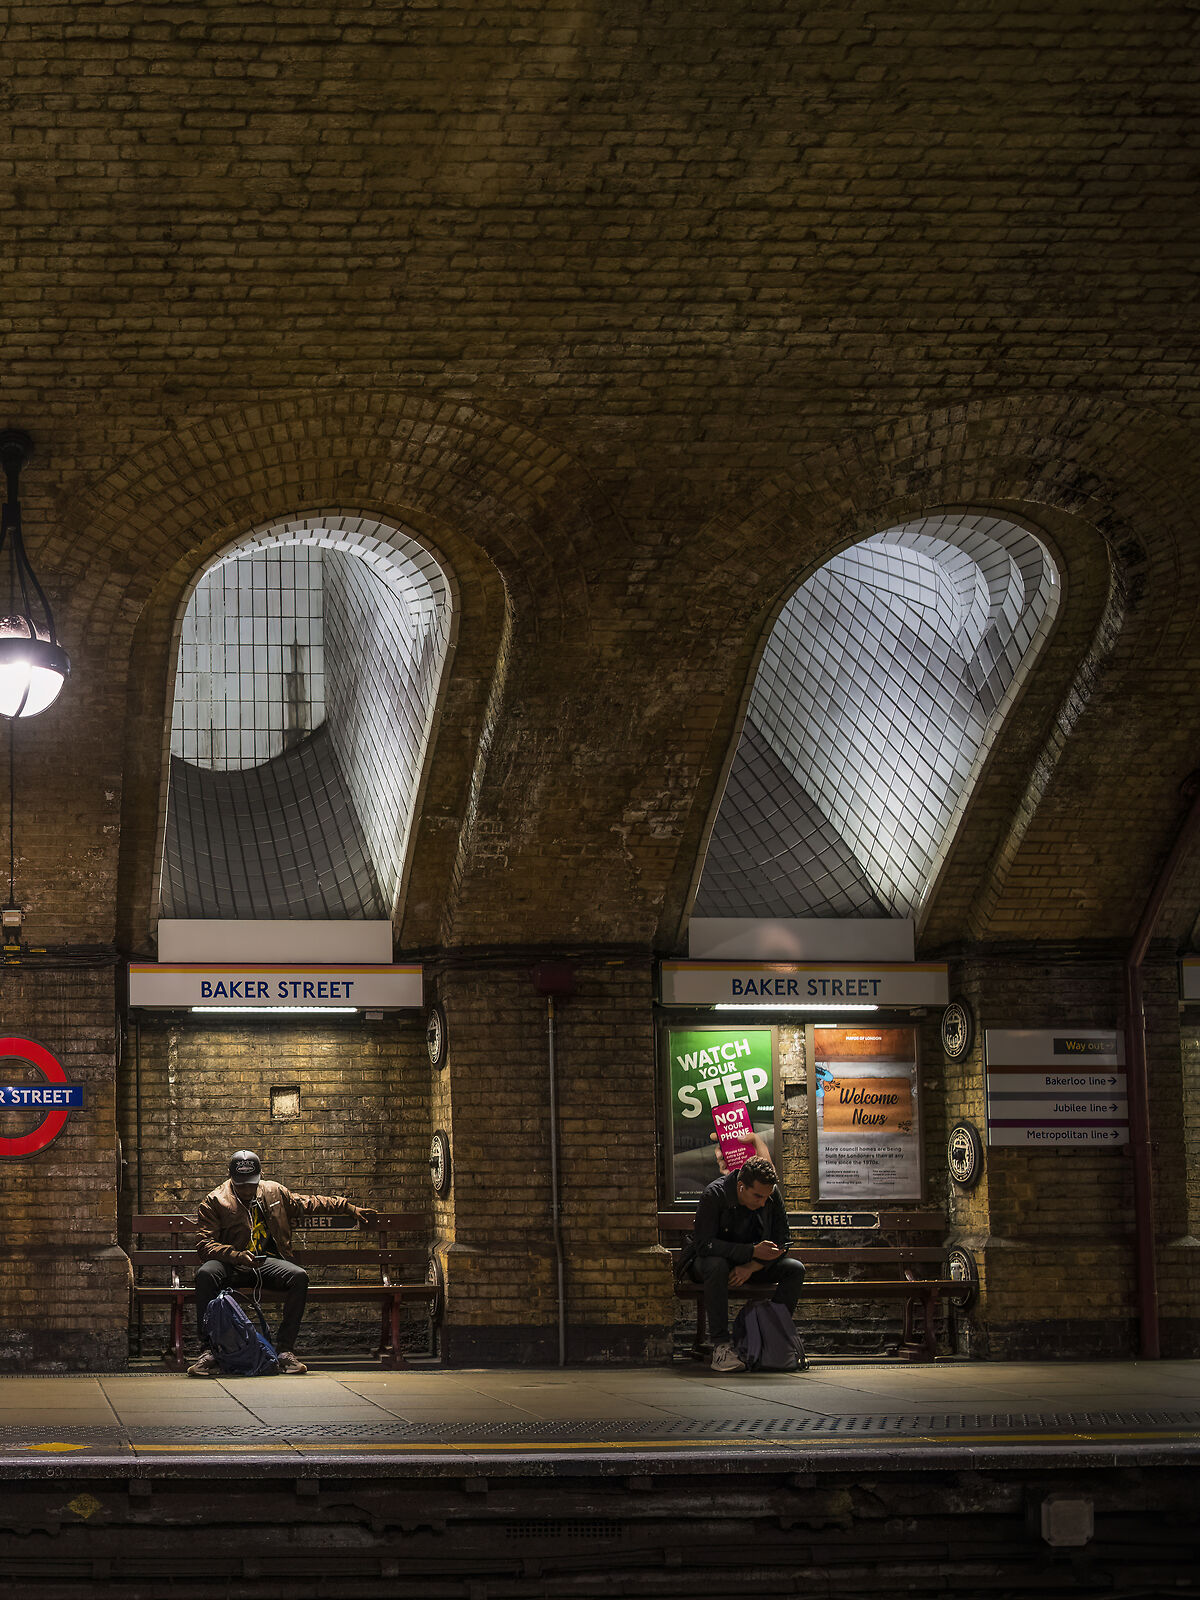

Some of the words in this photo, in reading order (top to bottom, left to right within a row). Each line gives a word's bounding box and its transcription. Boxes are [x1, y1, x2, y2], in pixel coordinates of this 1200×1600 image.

[200, 981, 270, 998] BAKER
[278, 981, 354, 998] STREET
[732, 979, 799, 996] BAKER
[807, 980, 882, 996] STREET
[1065, 1040, 1086, 1052] Way
[1088, 1042, 1104, 1050] out
[677, 1039, 751, 1072] WATCH
[699, 1061, 737, 1079] YOUR
[1046, 1077, 1086, 1085] Bakerloo
[1089, 1077, 1106, 1085] line
[10, 1089, 72, 1104] STREET
[678, 1068, 768, 1118] STEP
[840, 1088, 899, 1104] Welcome
[1054, 1104, 1086, 1112] Jubilee
[1090, 1104, 1107, 1112] line
[714, 1108, 745, 1126] NOT
[852, 1108, 888, 1125] News
[723, 1121, 743, 1132] YOUR
[721, 1128, 750, 1142] PHONE
[1027, 1131, 1088, 1140] Metropolitan
[1091, 1131, 1108, 1139] line
[290, 1216, 333, 1228] STREET
[811, 1215, 853, 1225] STREET
